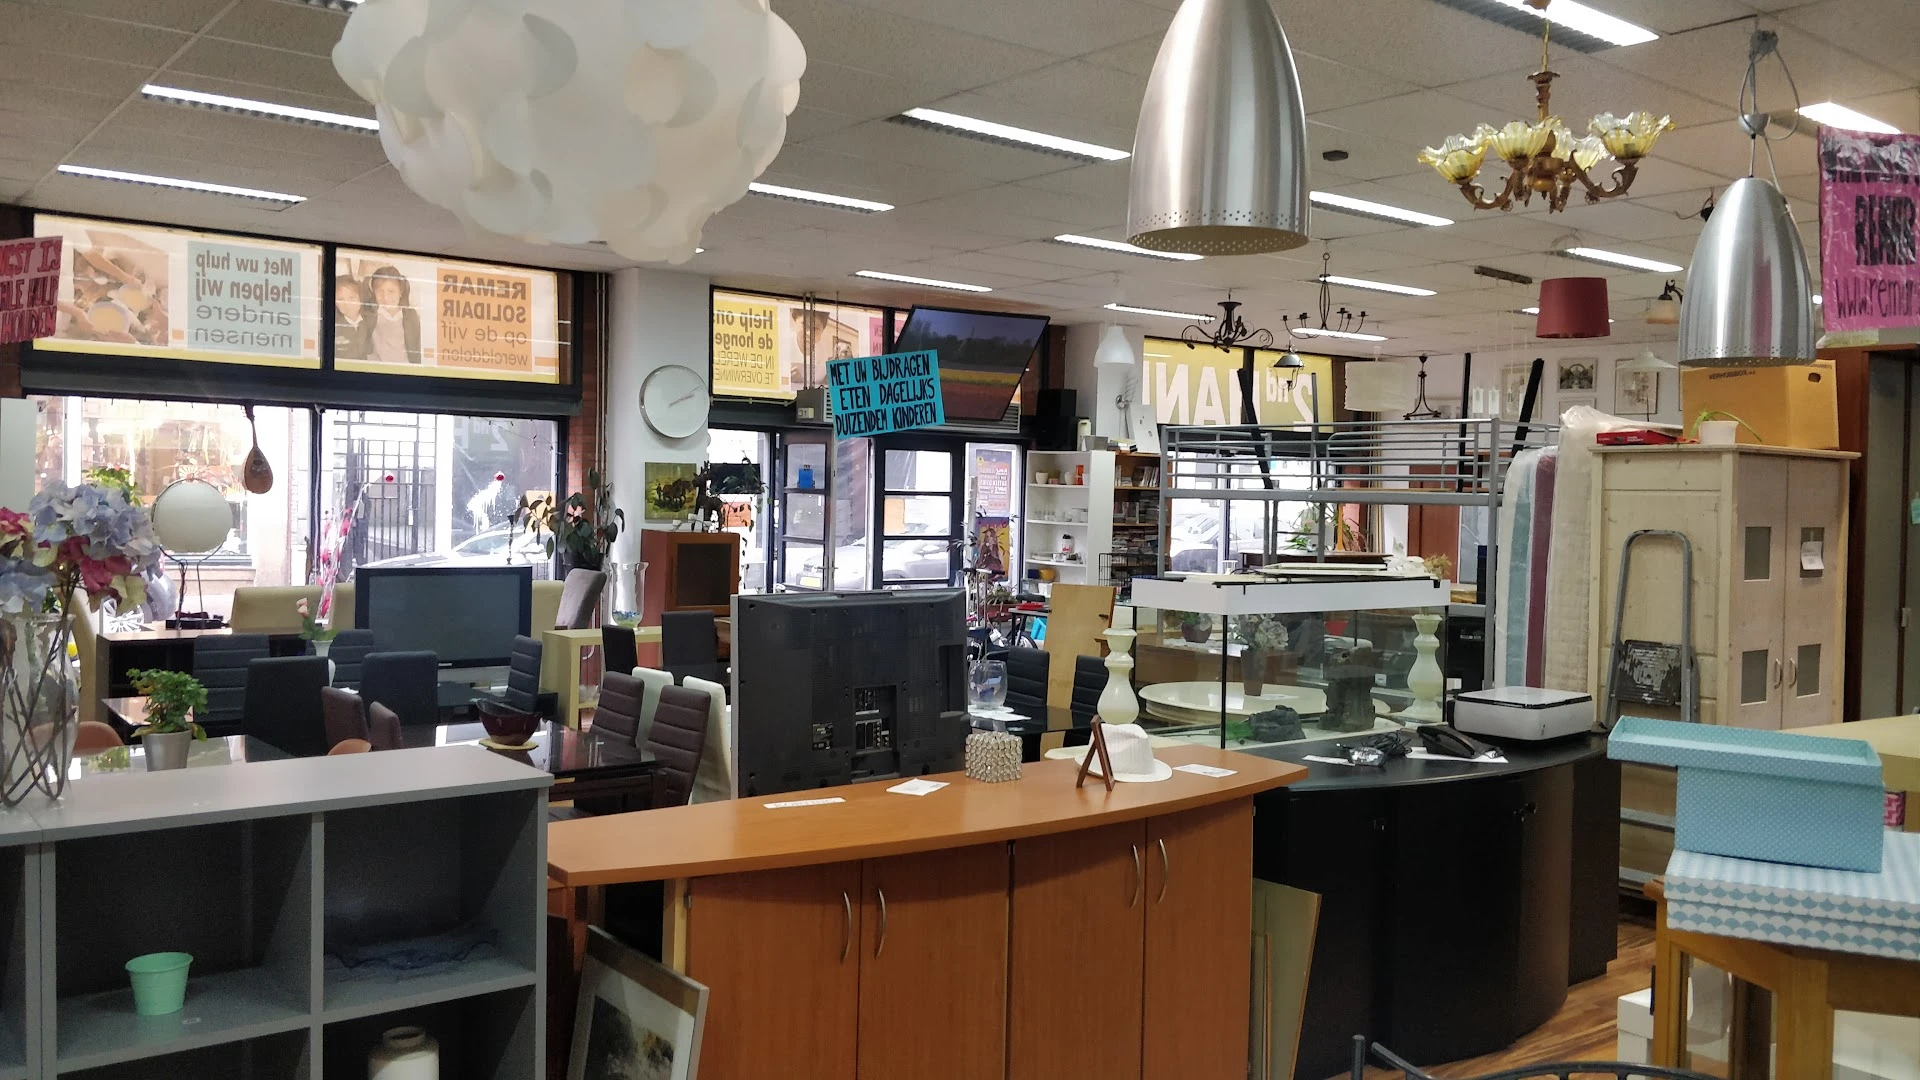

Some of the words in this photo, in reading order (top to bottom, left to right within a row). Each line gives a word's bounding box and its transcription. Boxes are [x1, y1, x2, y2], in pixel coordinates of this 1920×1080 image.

[830, 361, 850, 387] MET
[854, 360, 867, 382] UW
[872, 354, 931, 381] BIJDRAGEN
[840, 386, 871, 411] ETEN
[879, 378, 935, 406] DAGELIJKS
[892, 402, 937, 430] KINDEREN
